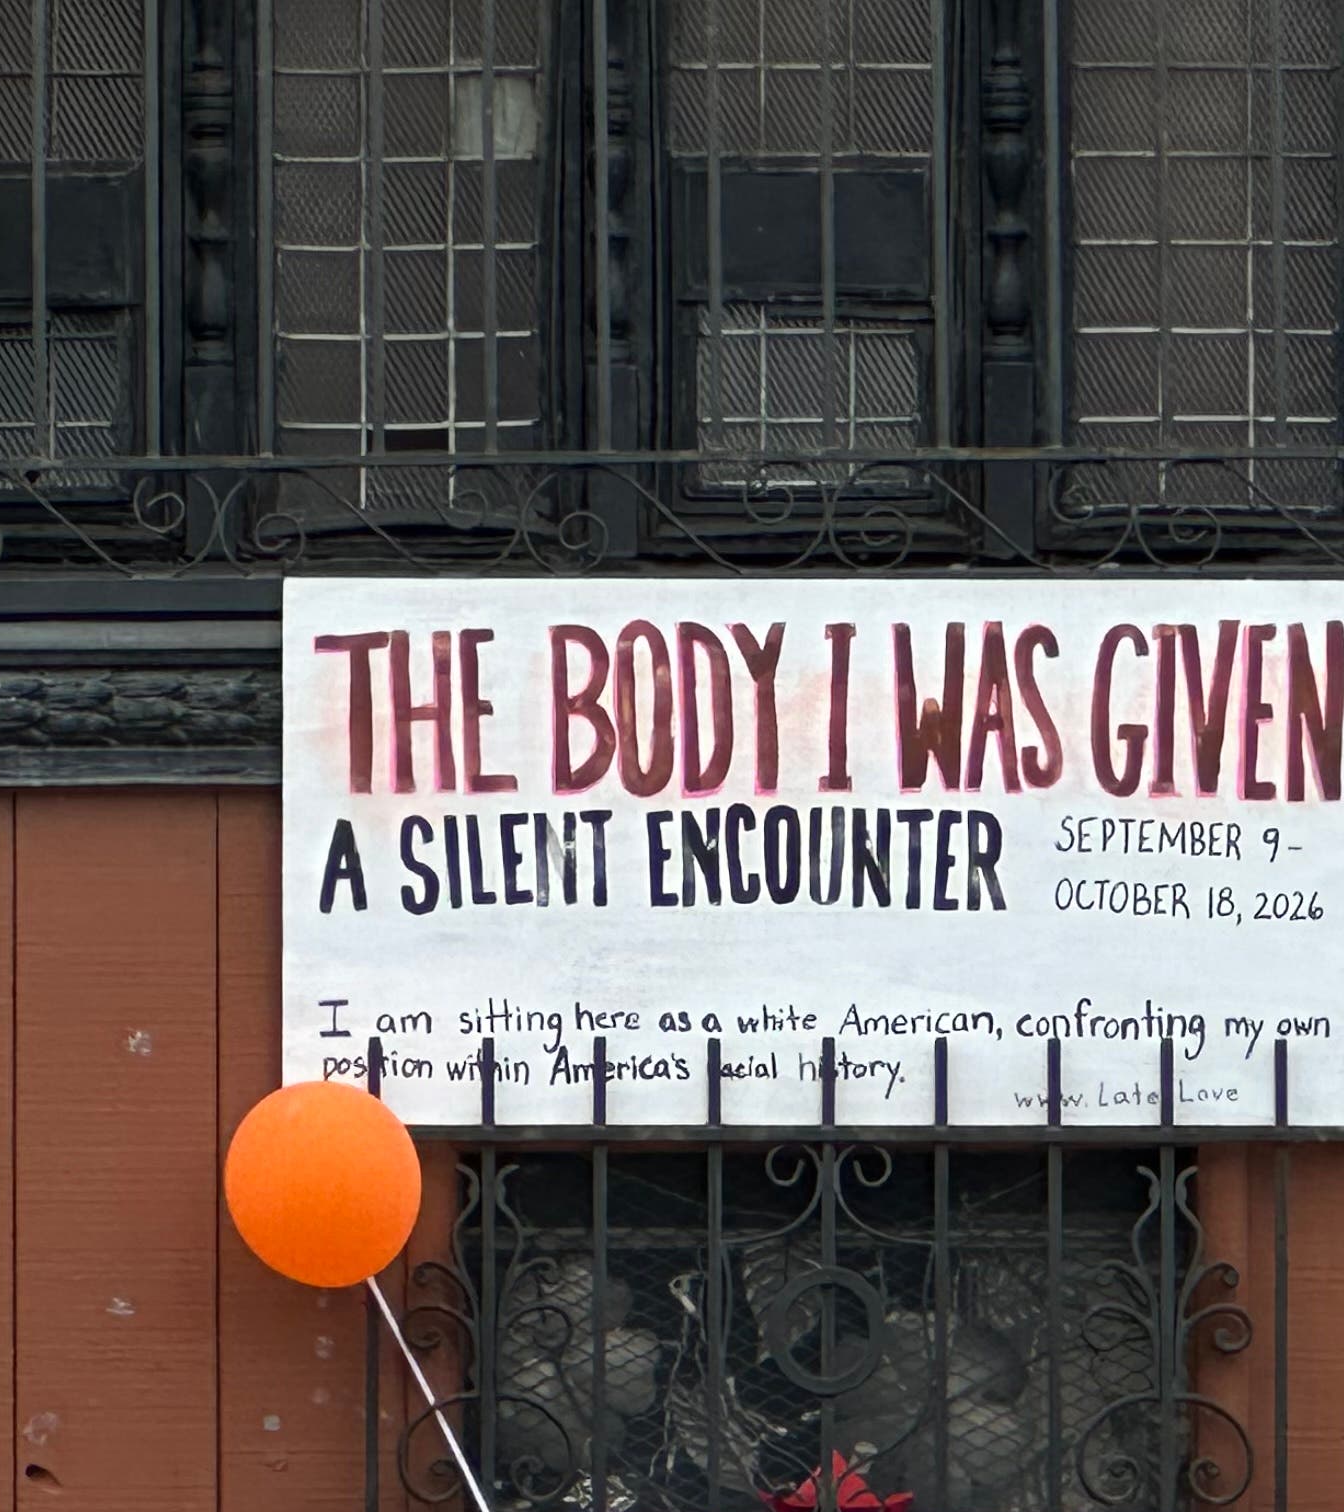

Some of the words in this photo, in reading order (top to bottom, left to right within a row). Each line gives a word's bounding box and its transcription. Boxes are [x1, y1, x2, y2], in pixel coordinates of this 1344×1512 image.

[314, 629, 518, 794] THE
[548, 619, 786, 797] BODY
[819, 623, 856, 793] I
[892, 620, 1064, 794] WAS
[319, 819, 367, 913] A
[400, 810, 612, 915] SILENT
[646, 803, 1007, 911] ENCOUNTER
[1055, 816, 1241, 860] SEPTEMBER
[1055, 878, 1190, 918] OCTOBER
[1208, 887, 1242, 925] 18,
[1254, 891, 1324, 920] 2026
[319, 999, 350, 1037] I
[377, 1013, 432, 1035] am
[460, 997, 561, 1053] sitting
[575, 1003, 641, 1030] here
[660, 1011, 691, 1032] as
[703, 1013, 721, 1032] a
[737, 1004, 817, 1032] white
[839, 1003, 1002, 1040] American,
[1016, 998, 1205, 1060] confronting
[1225, 1017, 1263, 1060] my
[1277, 1016, 1330, 1038] own
[720, 1052, 778, 1080] acial
